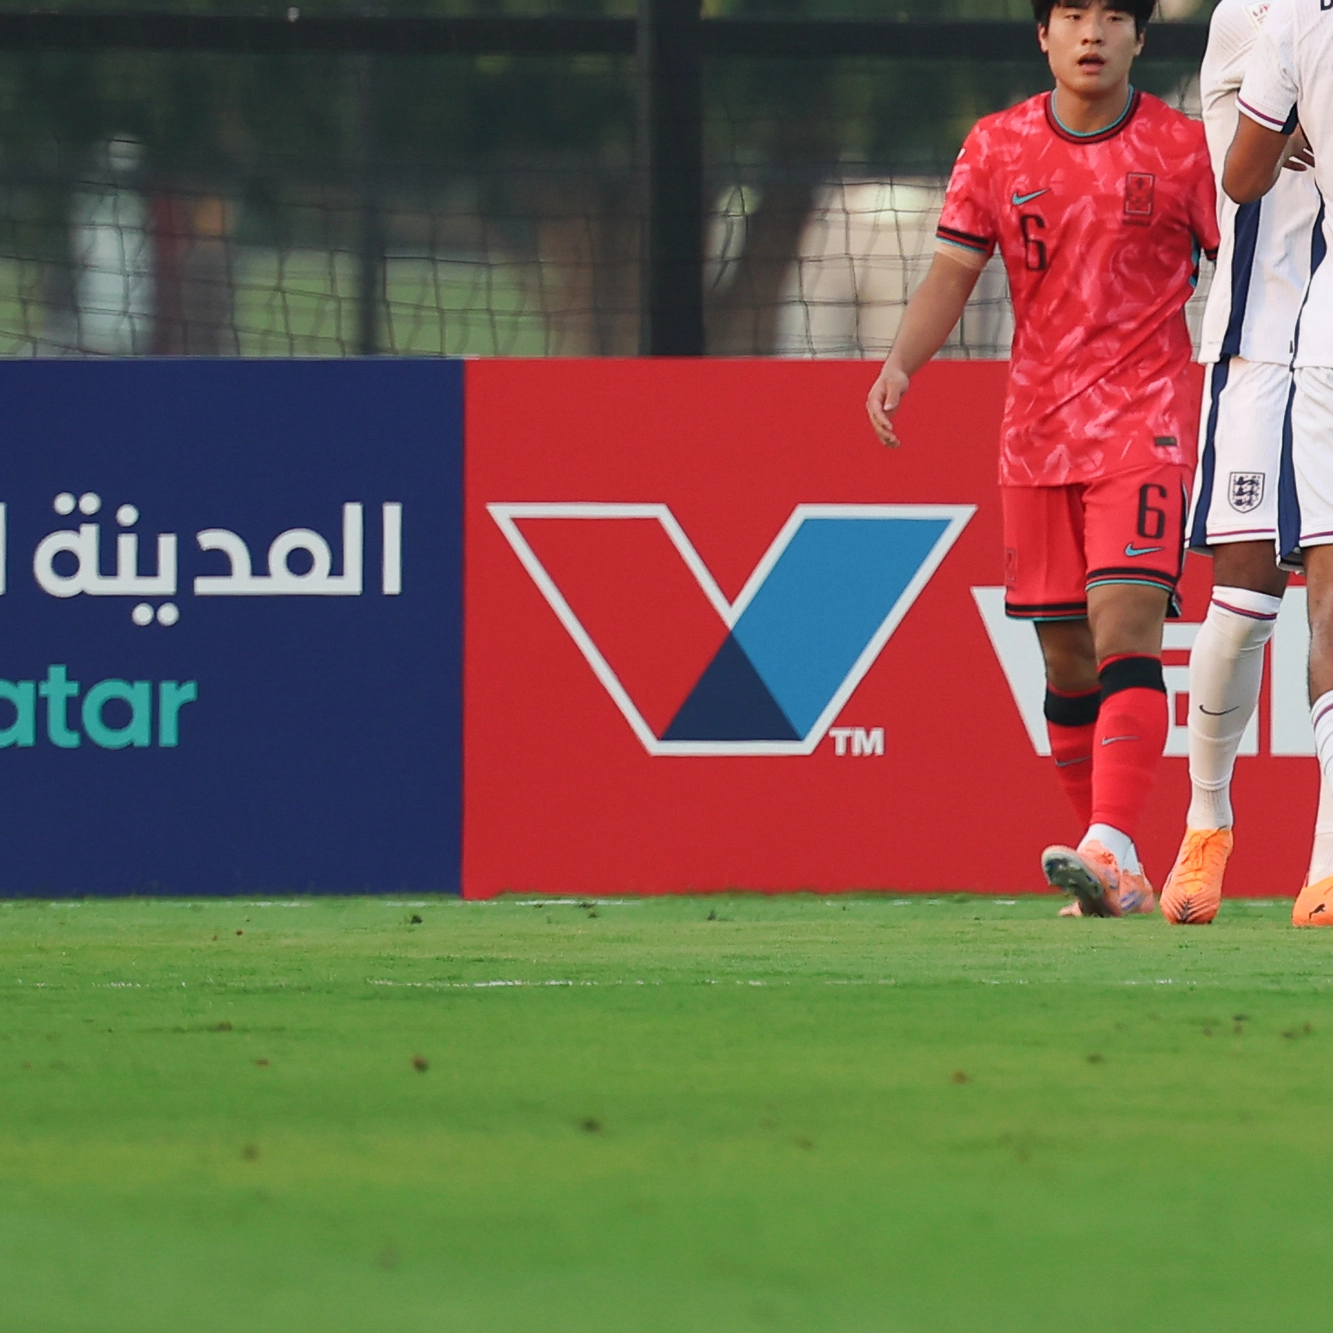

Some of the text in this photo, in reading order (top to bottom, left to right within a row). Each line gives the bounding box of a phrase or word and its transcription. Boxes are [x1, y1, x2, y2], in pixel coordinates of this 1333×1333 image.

[1020, 214, 1046, 272] 6
[1137, 482, 1167, 540] 6
[33, 491, 402, 627] المدينة
